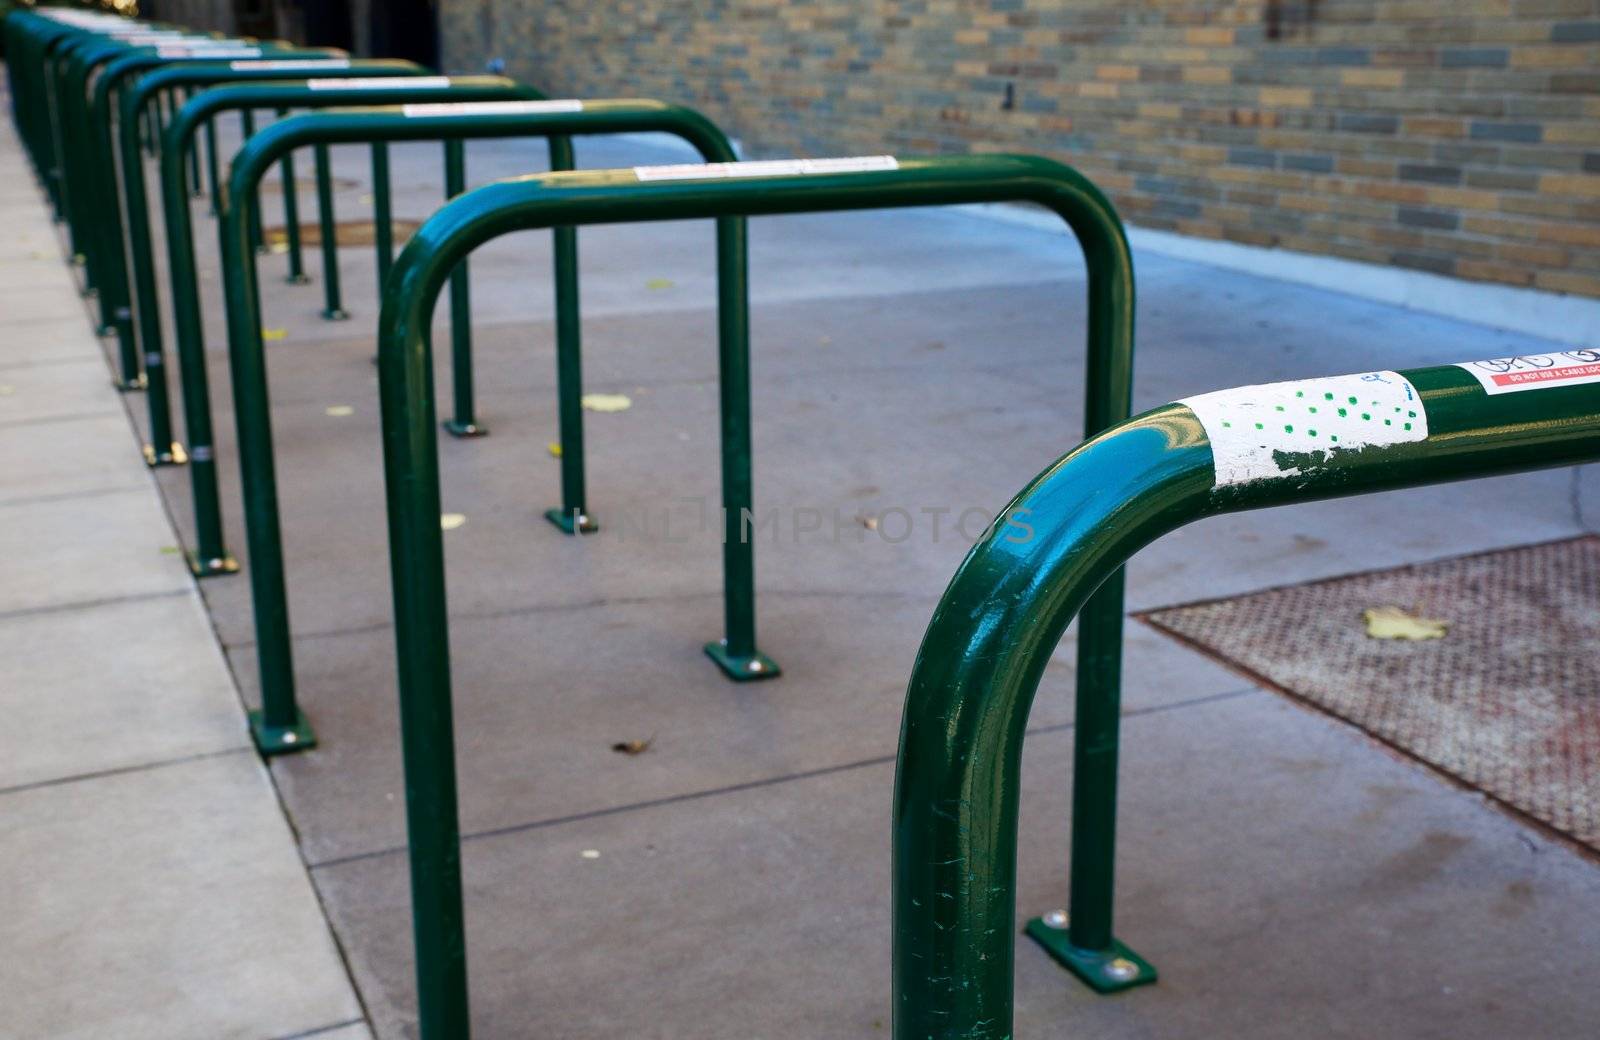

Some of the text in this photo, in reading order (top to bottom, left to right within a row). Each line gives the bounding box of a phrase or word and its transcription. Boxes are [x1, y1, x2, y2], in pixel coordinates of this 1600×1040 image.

[1510, 374, 1522, 382] DO
[1523, 372, 1539, 380] NOT
[1562, 367, 1586, 375] CABLE
